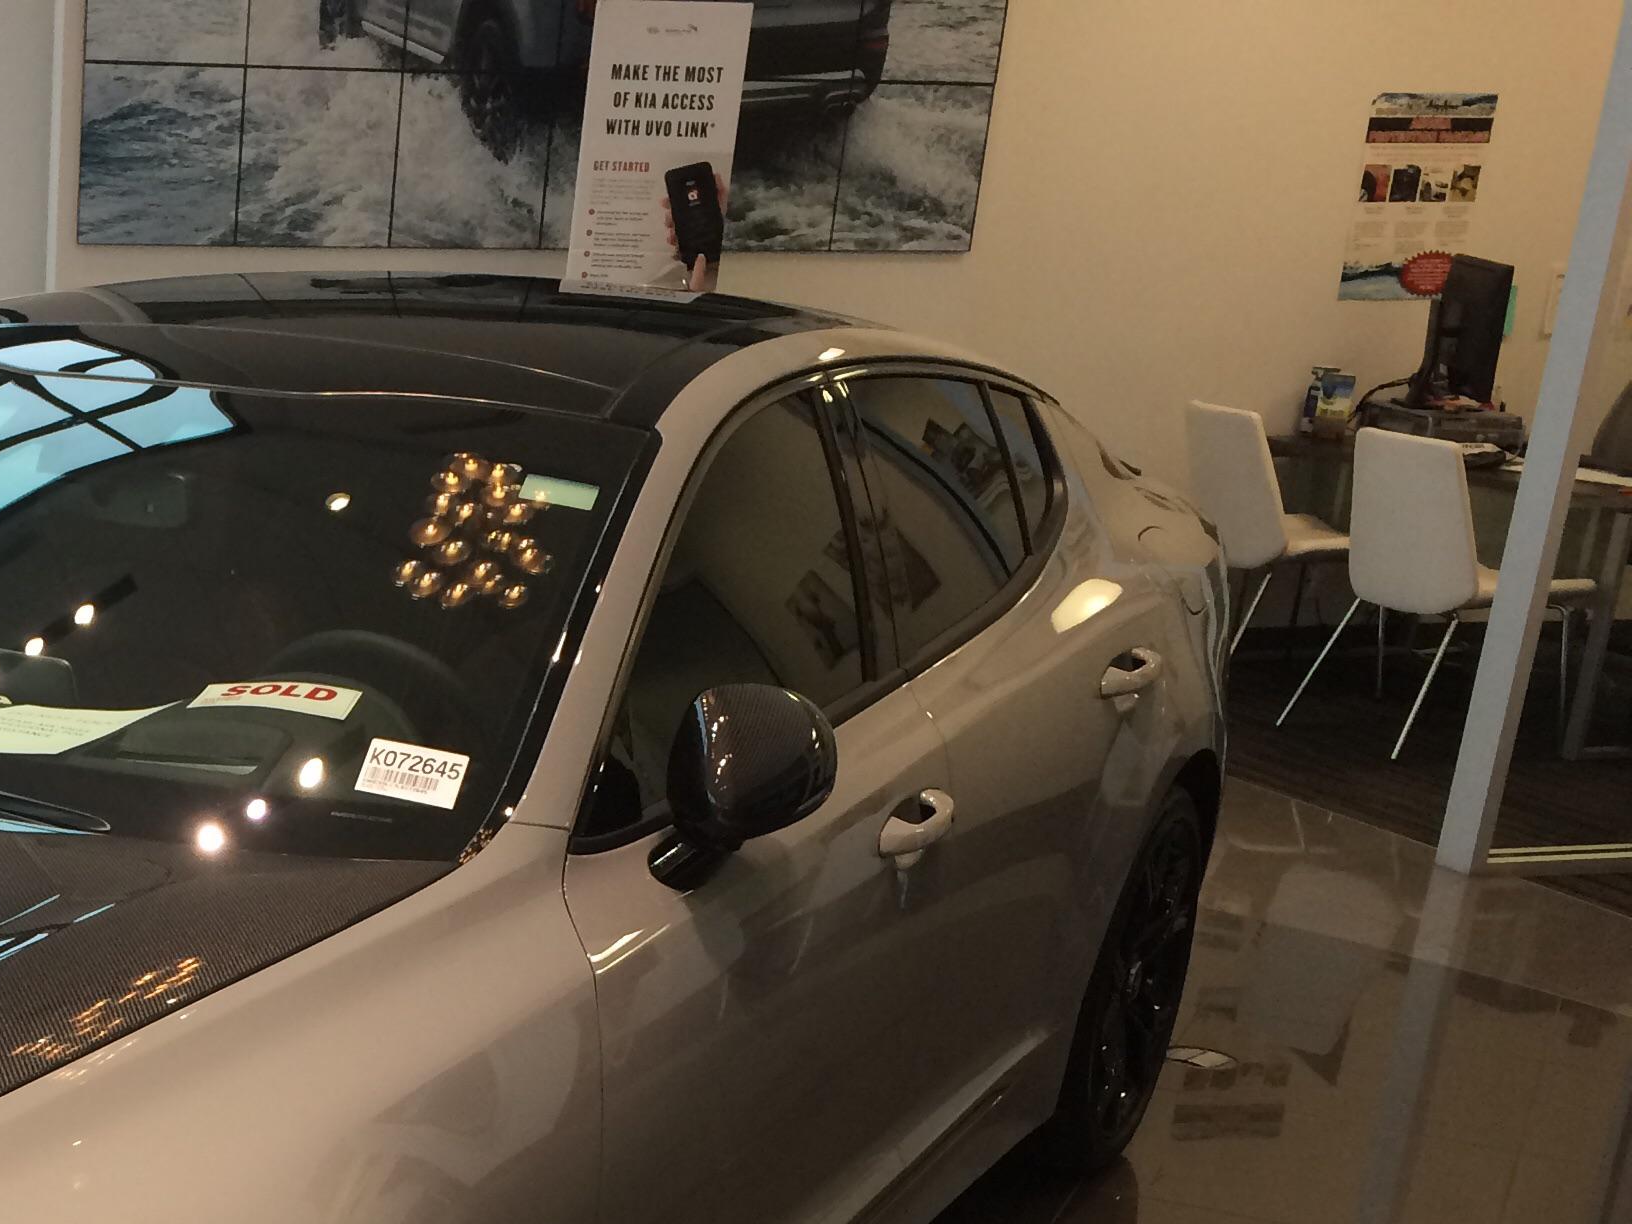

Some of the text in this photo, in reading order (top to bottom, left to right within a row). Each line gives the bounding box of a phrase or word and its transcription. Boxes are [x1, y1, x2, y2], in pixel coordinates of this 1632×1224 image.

[611, 64, 724, 83] MAKE THE MOST
[613, 92, 715, 111] OF KIA ACCESS
[606, 119, 640, 136] WITH
[646, 120, 672, 137] UVO
[593, 161, 650, 172] GET STARTED
[220, 684, 338, 701] SOLD
[370, 747, 463, 780] K072645
